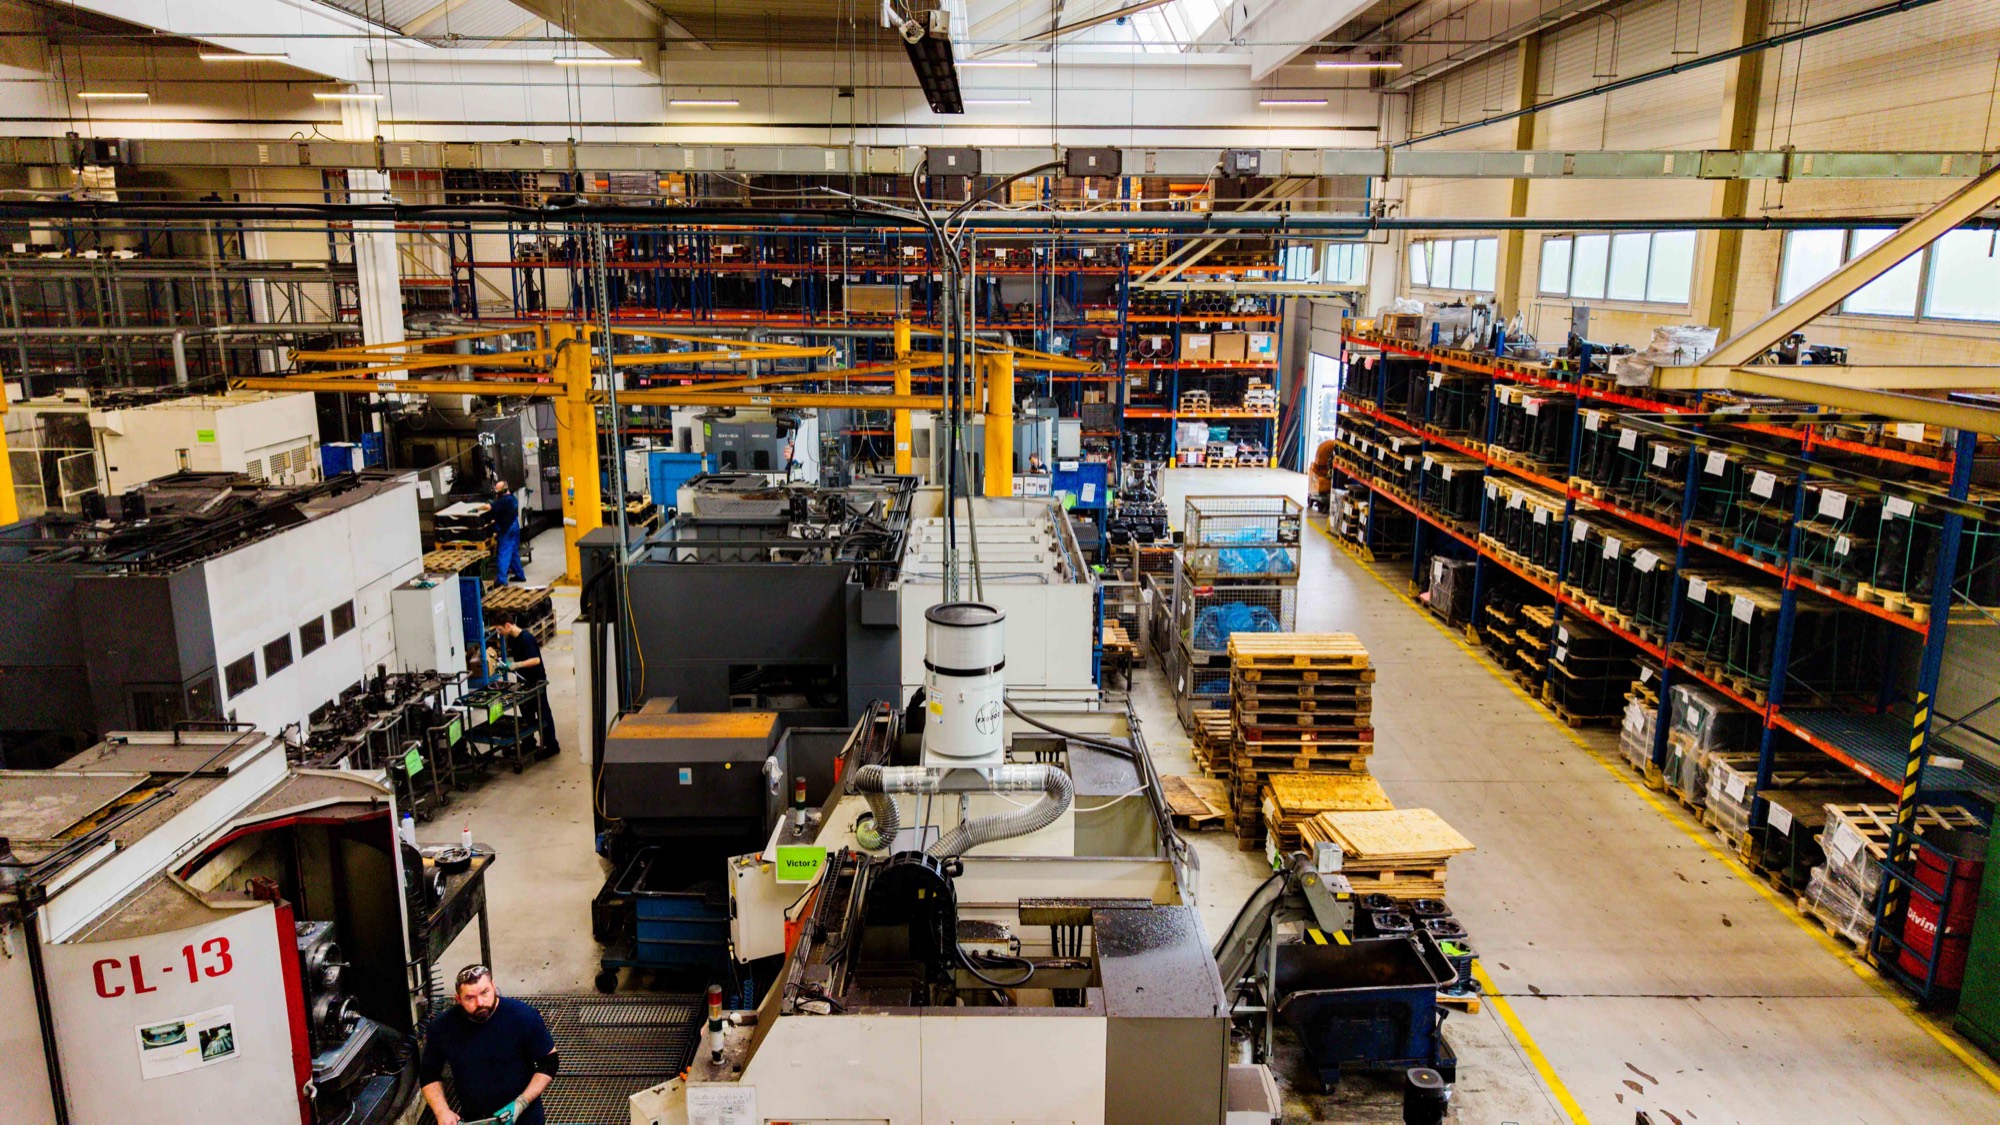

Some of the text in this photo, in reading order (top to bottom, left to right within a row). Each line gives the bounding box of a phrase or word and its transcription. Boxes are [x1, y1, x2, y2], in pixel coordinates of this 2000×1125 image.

[786, 859, 817, 867] Victor 2
[1907, 906, 1951, 934] Divin
[92, 936, 234, 999] CL-13
